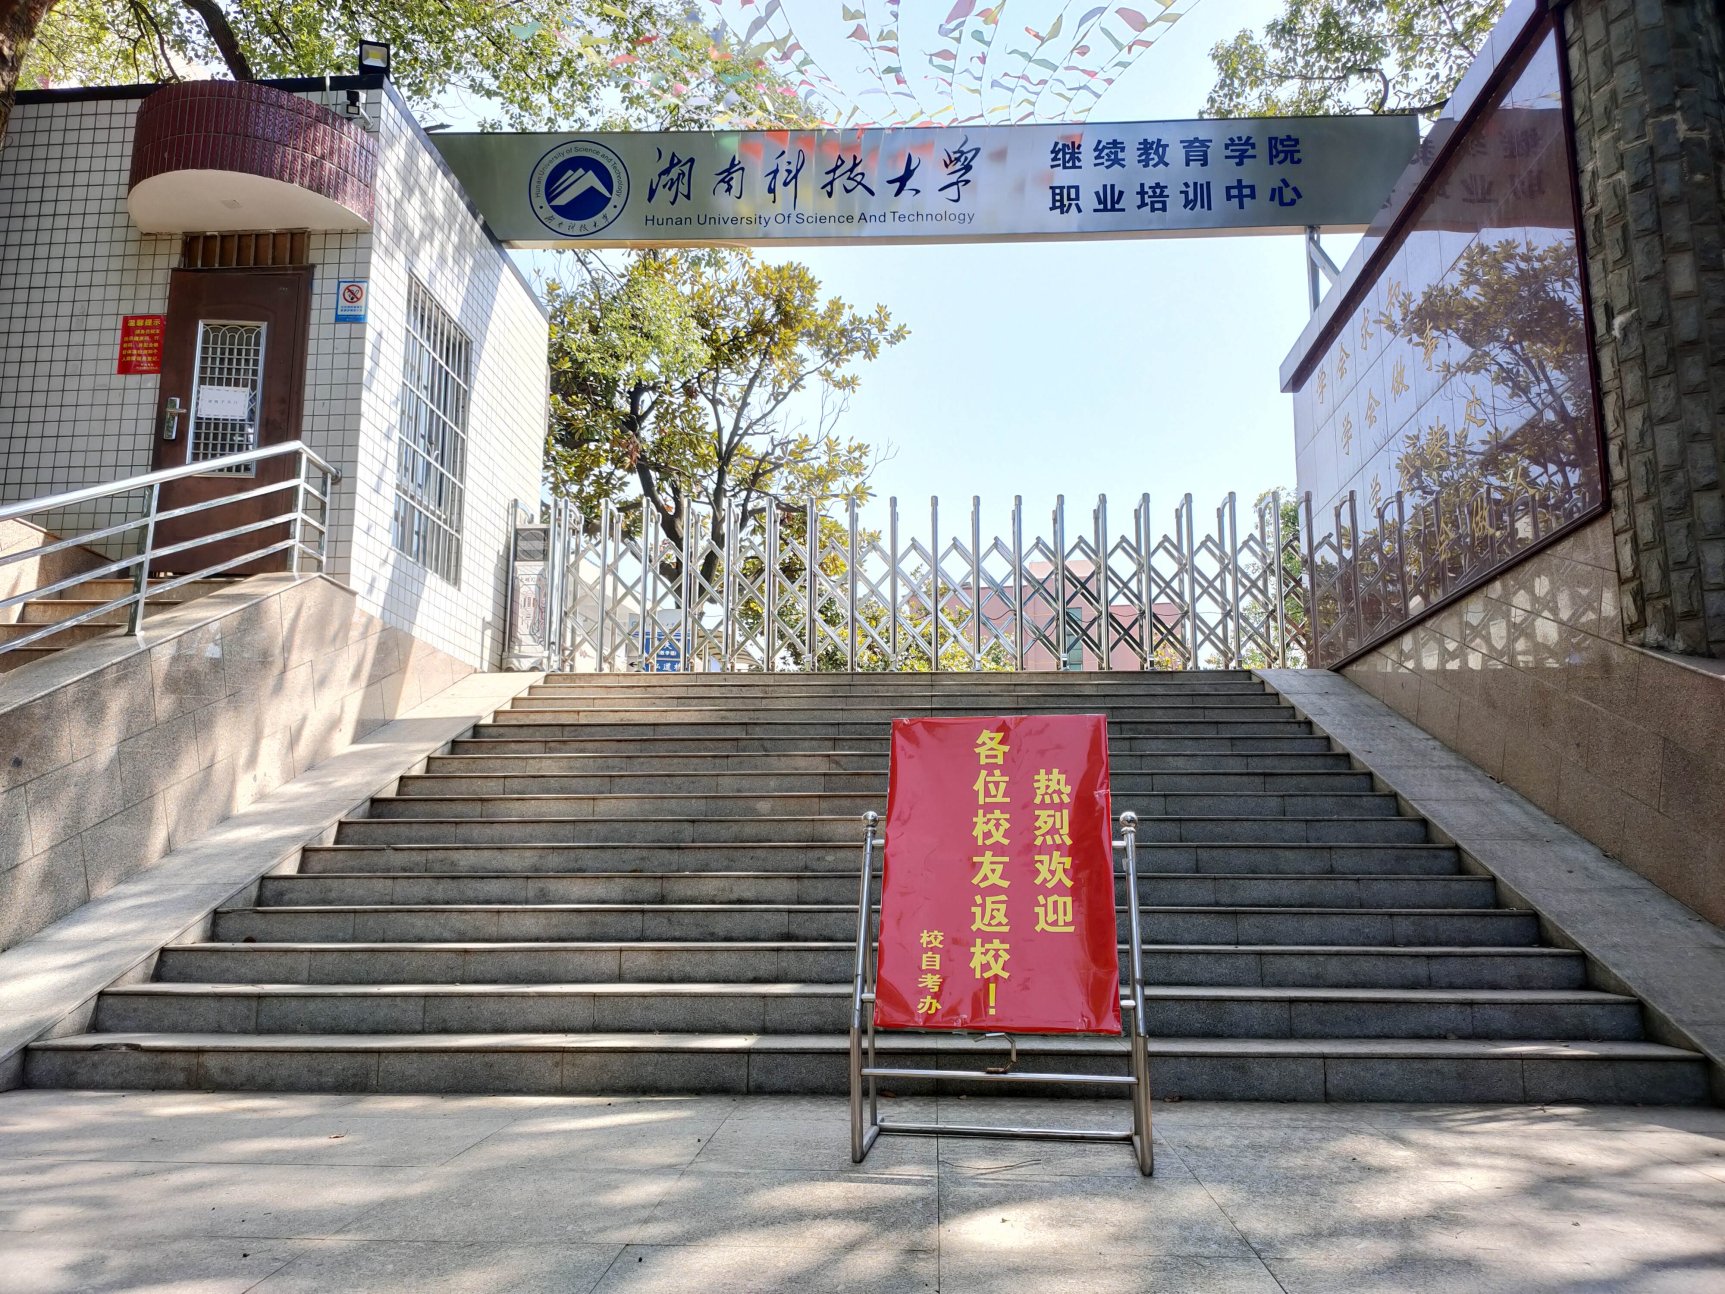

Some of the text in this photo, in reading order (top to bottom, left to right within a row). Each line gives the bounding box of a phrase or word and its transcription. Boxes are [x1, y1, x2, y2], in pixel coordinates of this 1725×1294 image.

[574, 147, 601, 156] Science
[600, 153, 613, 164] and
[1050, 134, 1303, 170] 继续教育学院
[647, 134, 982, 211] 湖南科技大学
[1049, 178, 1303, 215] 职业培训中心
[645, 210, 975, 228] Hunan University Of Science And Technology
[1033, 768, 1075, 933] 热烈欢迎
[917, 929, 944, 1014] 校自考办
